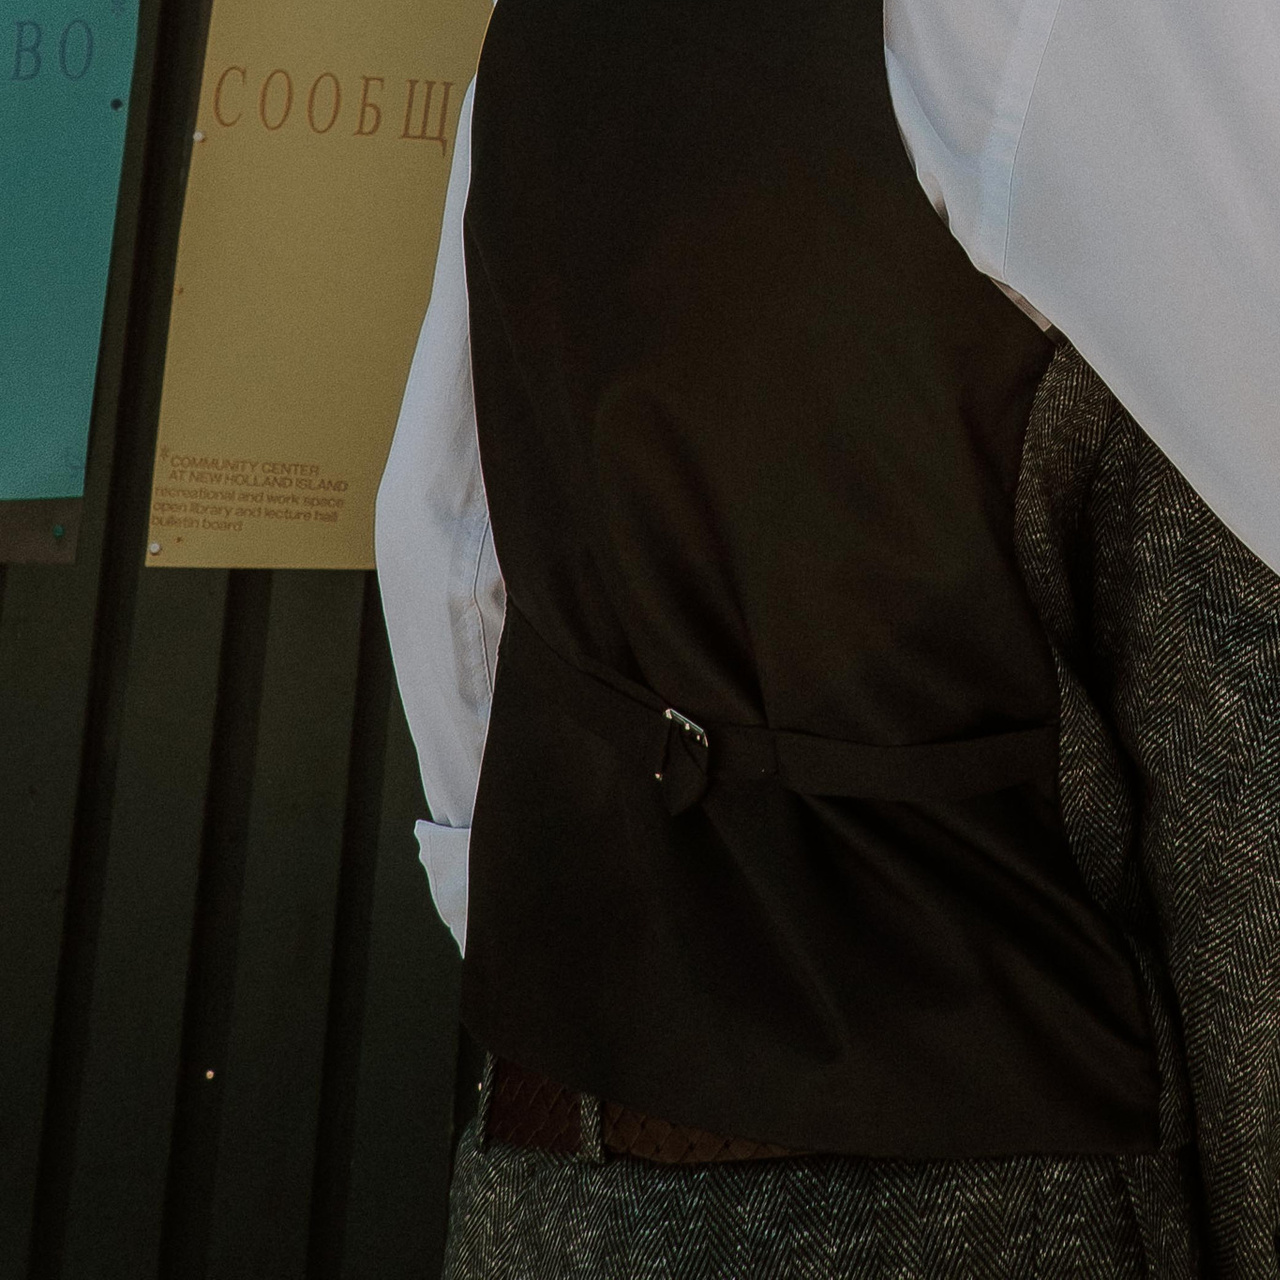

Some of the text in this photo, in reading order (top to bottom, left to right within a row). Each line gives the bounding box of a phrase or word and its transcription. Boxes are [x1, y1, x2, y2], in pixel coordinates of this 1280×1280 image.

[170, 455, 320, 477] COMMUNITY CENTER
[168, 469, 349, 492] AT NEW HOLLAND ISLAND
[154, 488, 345, 509] recreational and work space
[152, 501, 339, 522] open library and lecture hall
[201, 517, 244, 531] board
